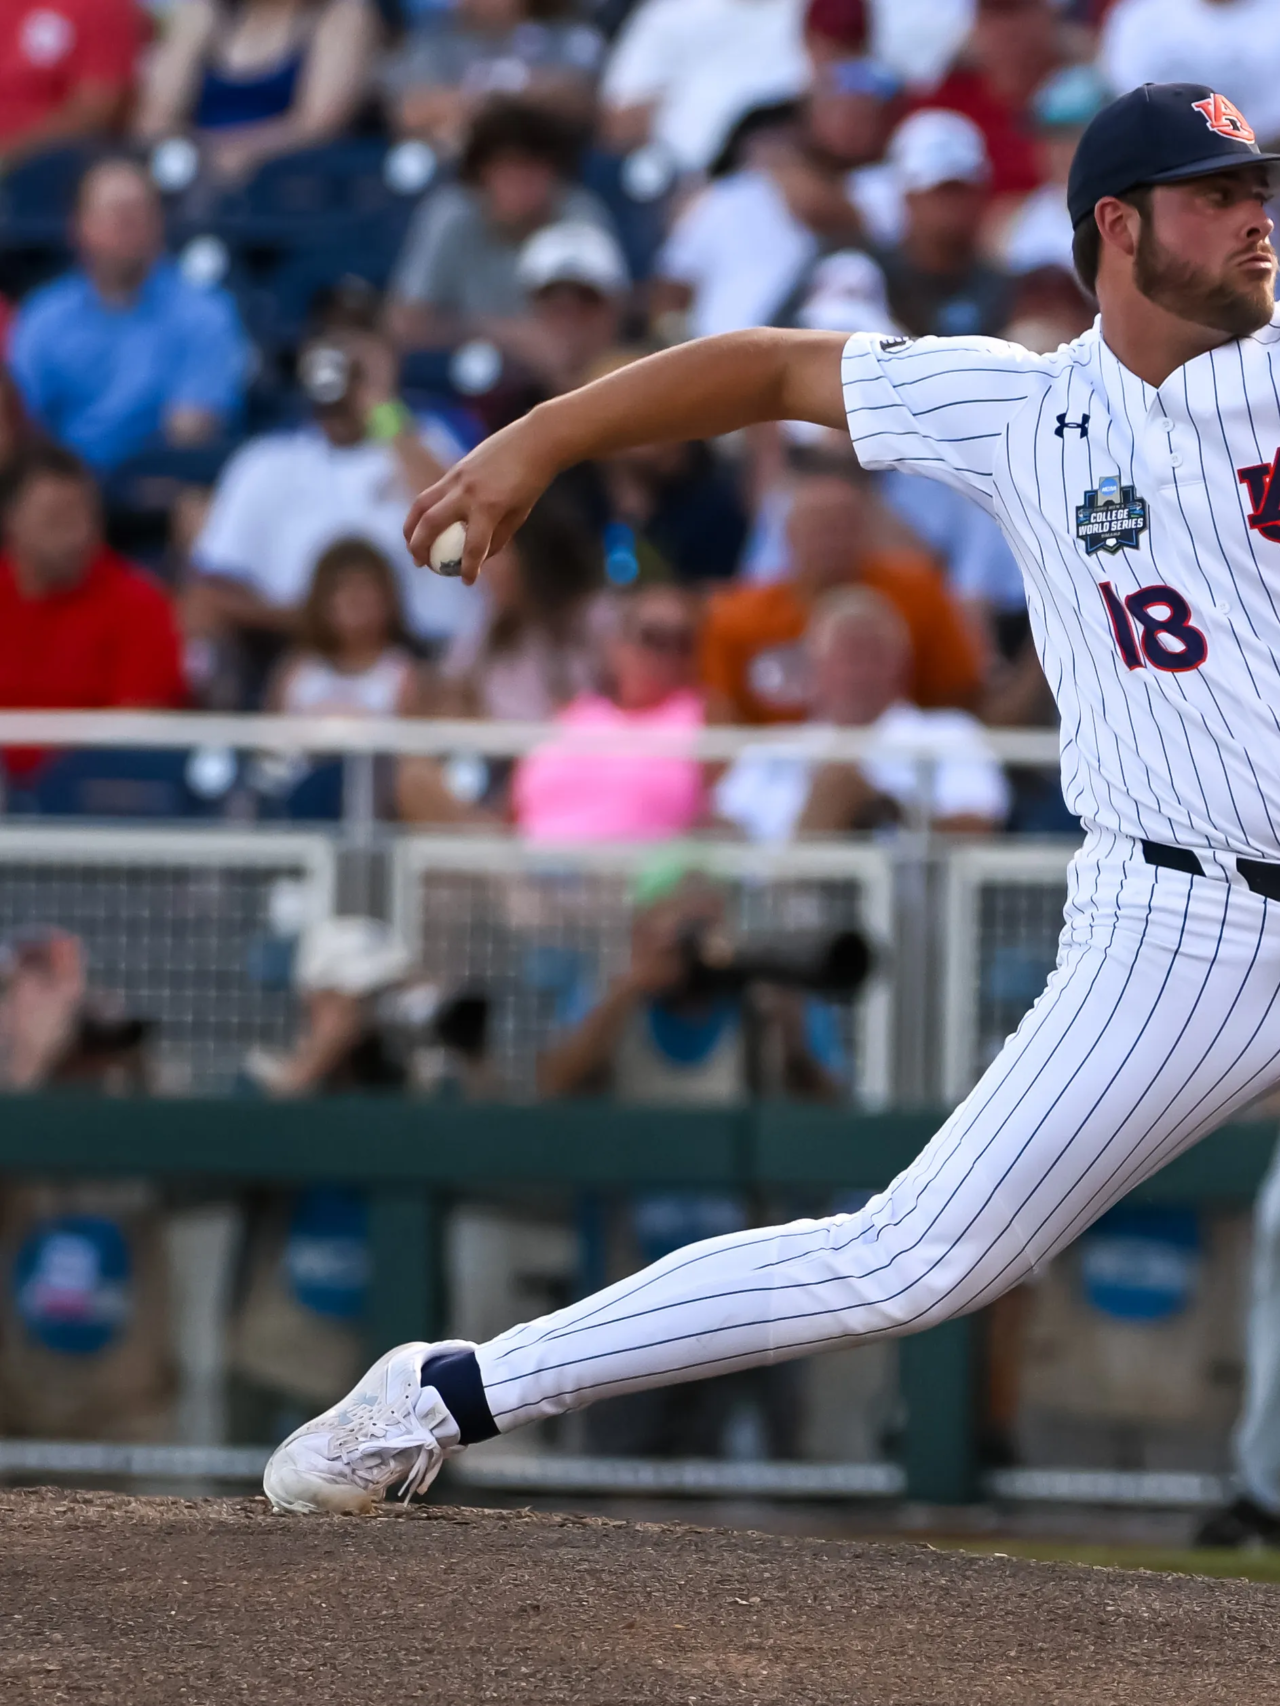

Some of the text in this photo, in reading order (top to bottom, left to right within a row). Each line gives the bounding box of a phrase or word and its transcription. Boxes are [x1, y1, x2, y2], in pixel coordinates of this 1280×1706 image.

[1090, 509, 1129, 523] COLLEGE
[1078, 518, 1144, 536] WORLD SERIES
[1098, 581, 1208, 673] 18
